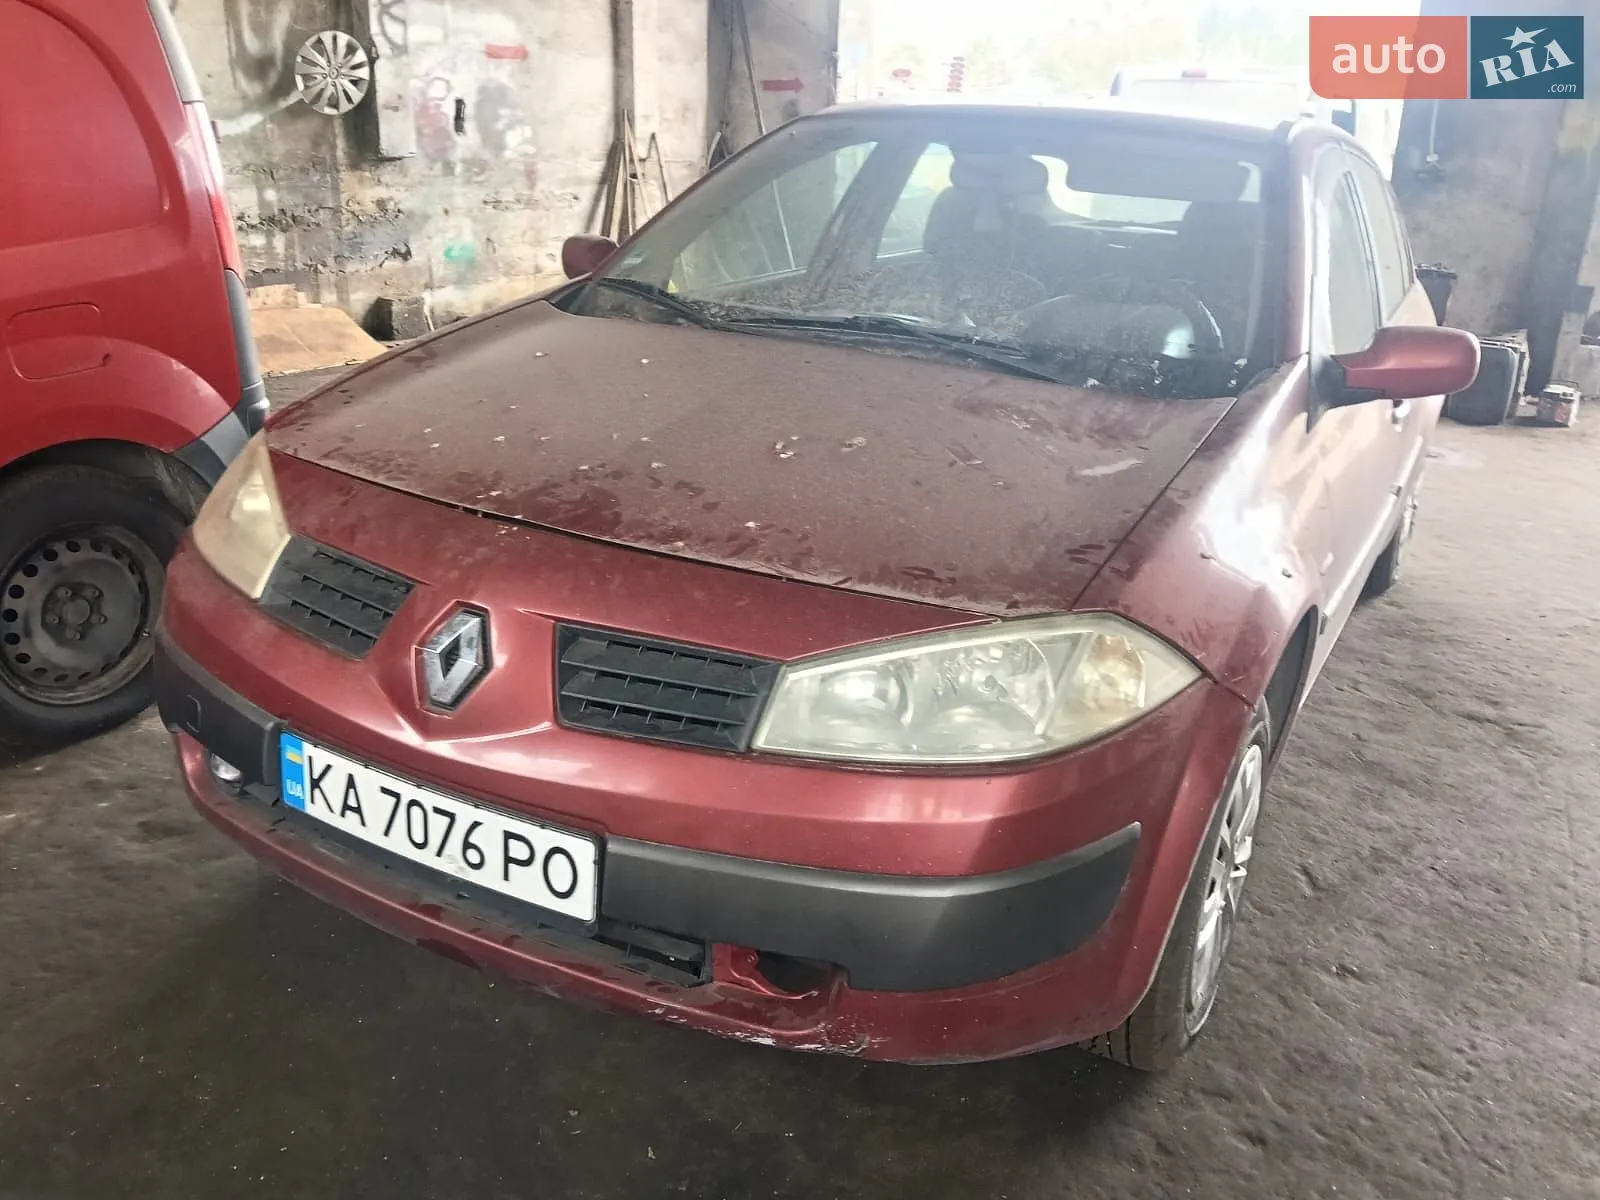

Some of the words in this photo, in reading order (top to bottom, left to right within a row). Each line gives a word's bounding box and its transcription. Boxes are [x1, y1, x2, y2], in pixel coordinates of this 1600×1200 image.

[286, 779, 304, 799] UA
[308, 755, 367, 827] KA
[379, 786, 485, 870] 7076
[503, 830, 578, 899] PO
